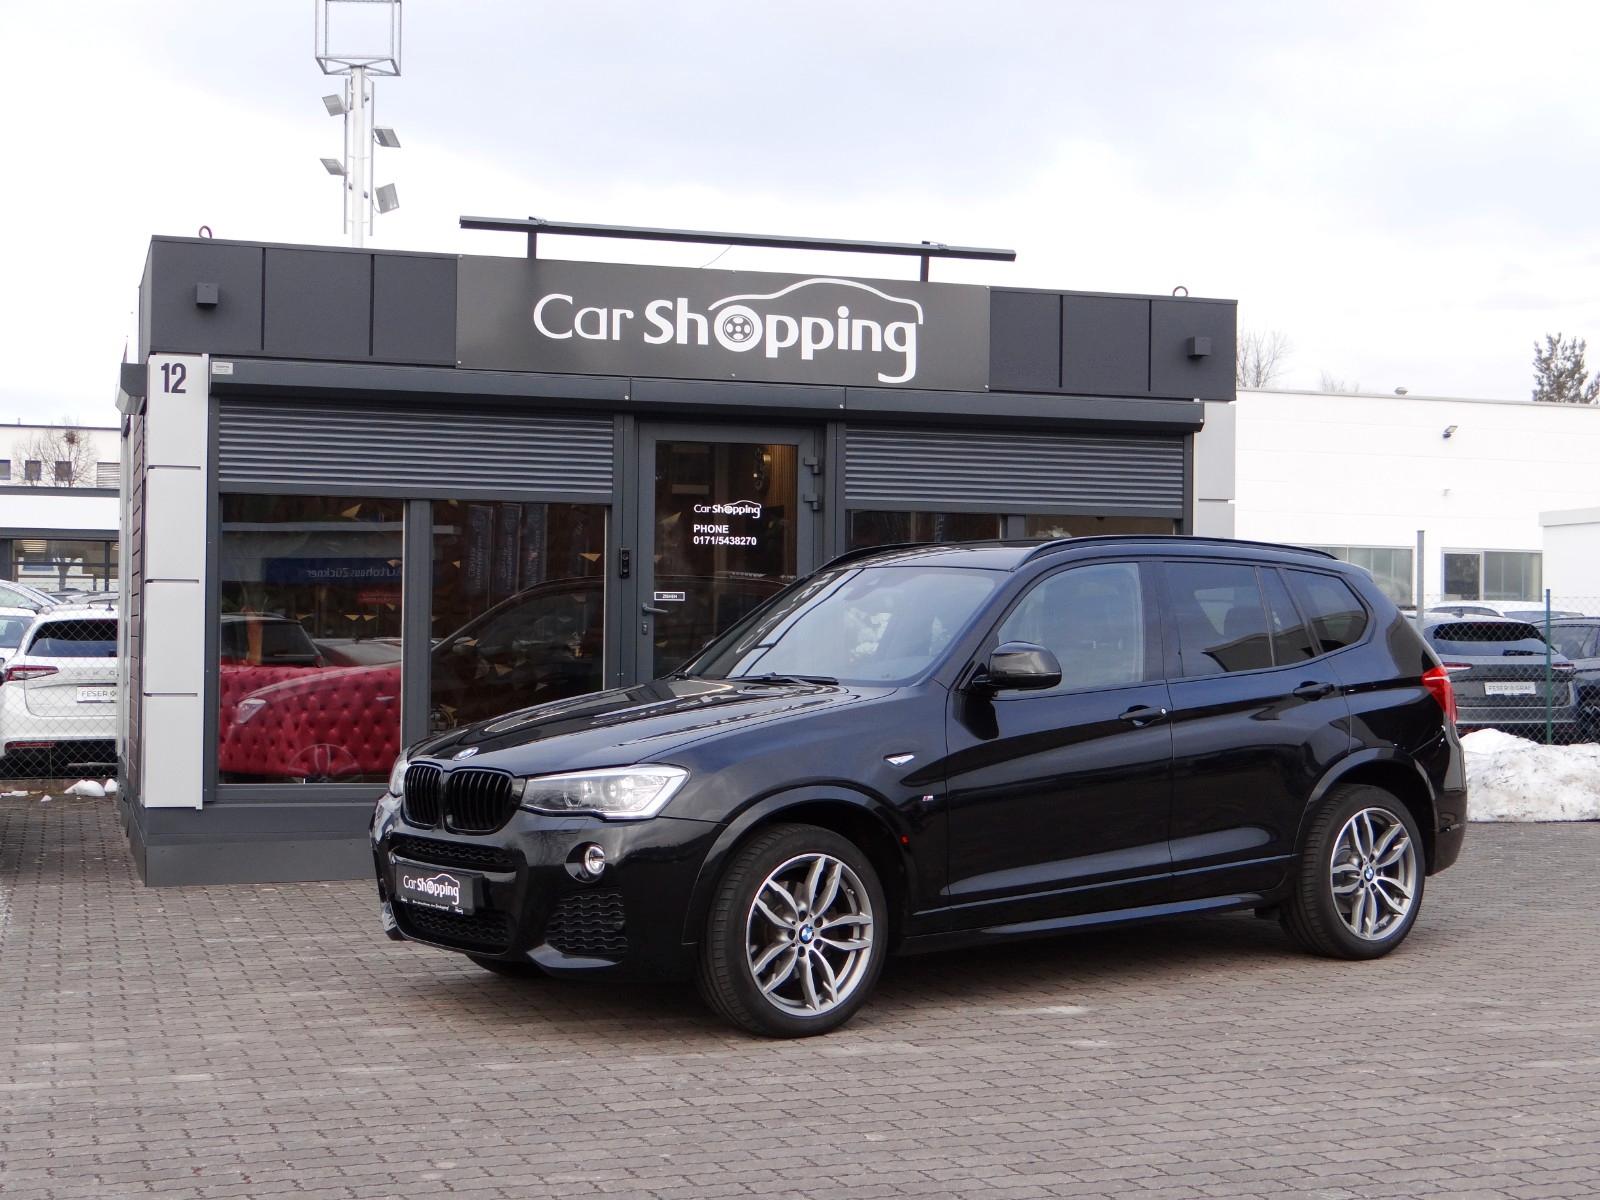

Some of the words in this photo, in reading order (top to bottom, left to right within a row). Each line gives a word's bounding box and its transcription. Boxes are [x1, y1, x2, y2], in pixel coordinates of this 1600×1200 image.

[533, 293, 634, 340] Car
[643, 297, 918, 384] Shopping
[161, 362, 186, 393] 12
[693, 504, 711, 513] Car
[712, 503, 761, 519] Shopping
[693, 524, 729, 534] PHONE
[693, 536, 757, 546] 0171/5438270
[403, 875, 416, 890] Car
[417, 877, 460, 905] Shopping
